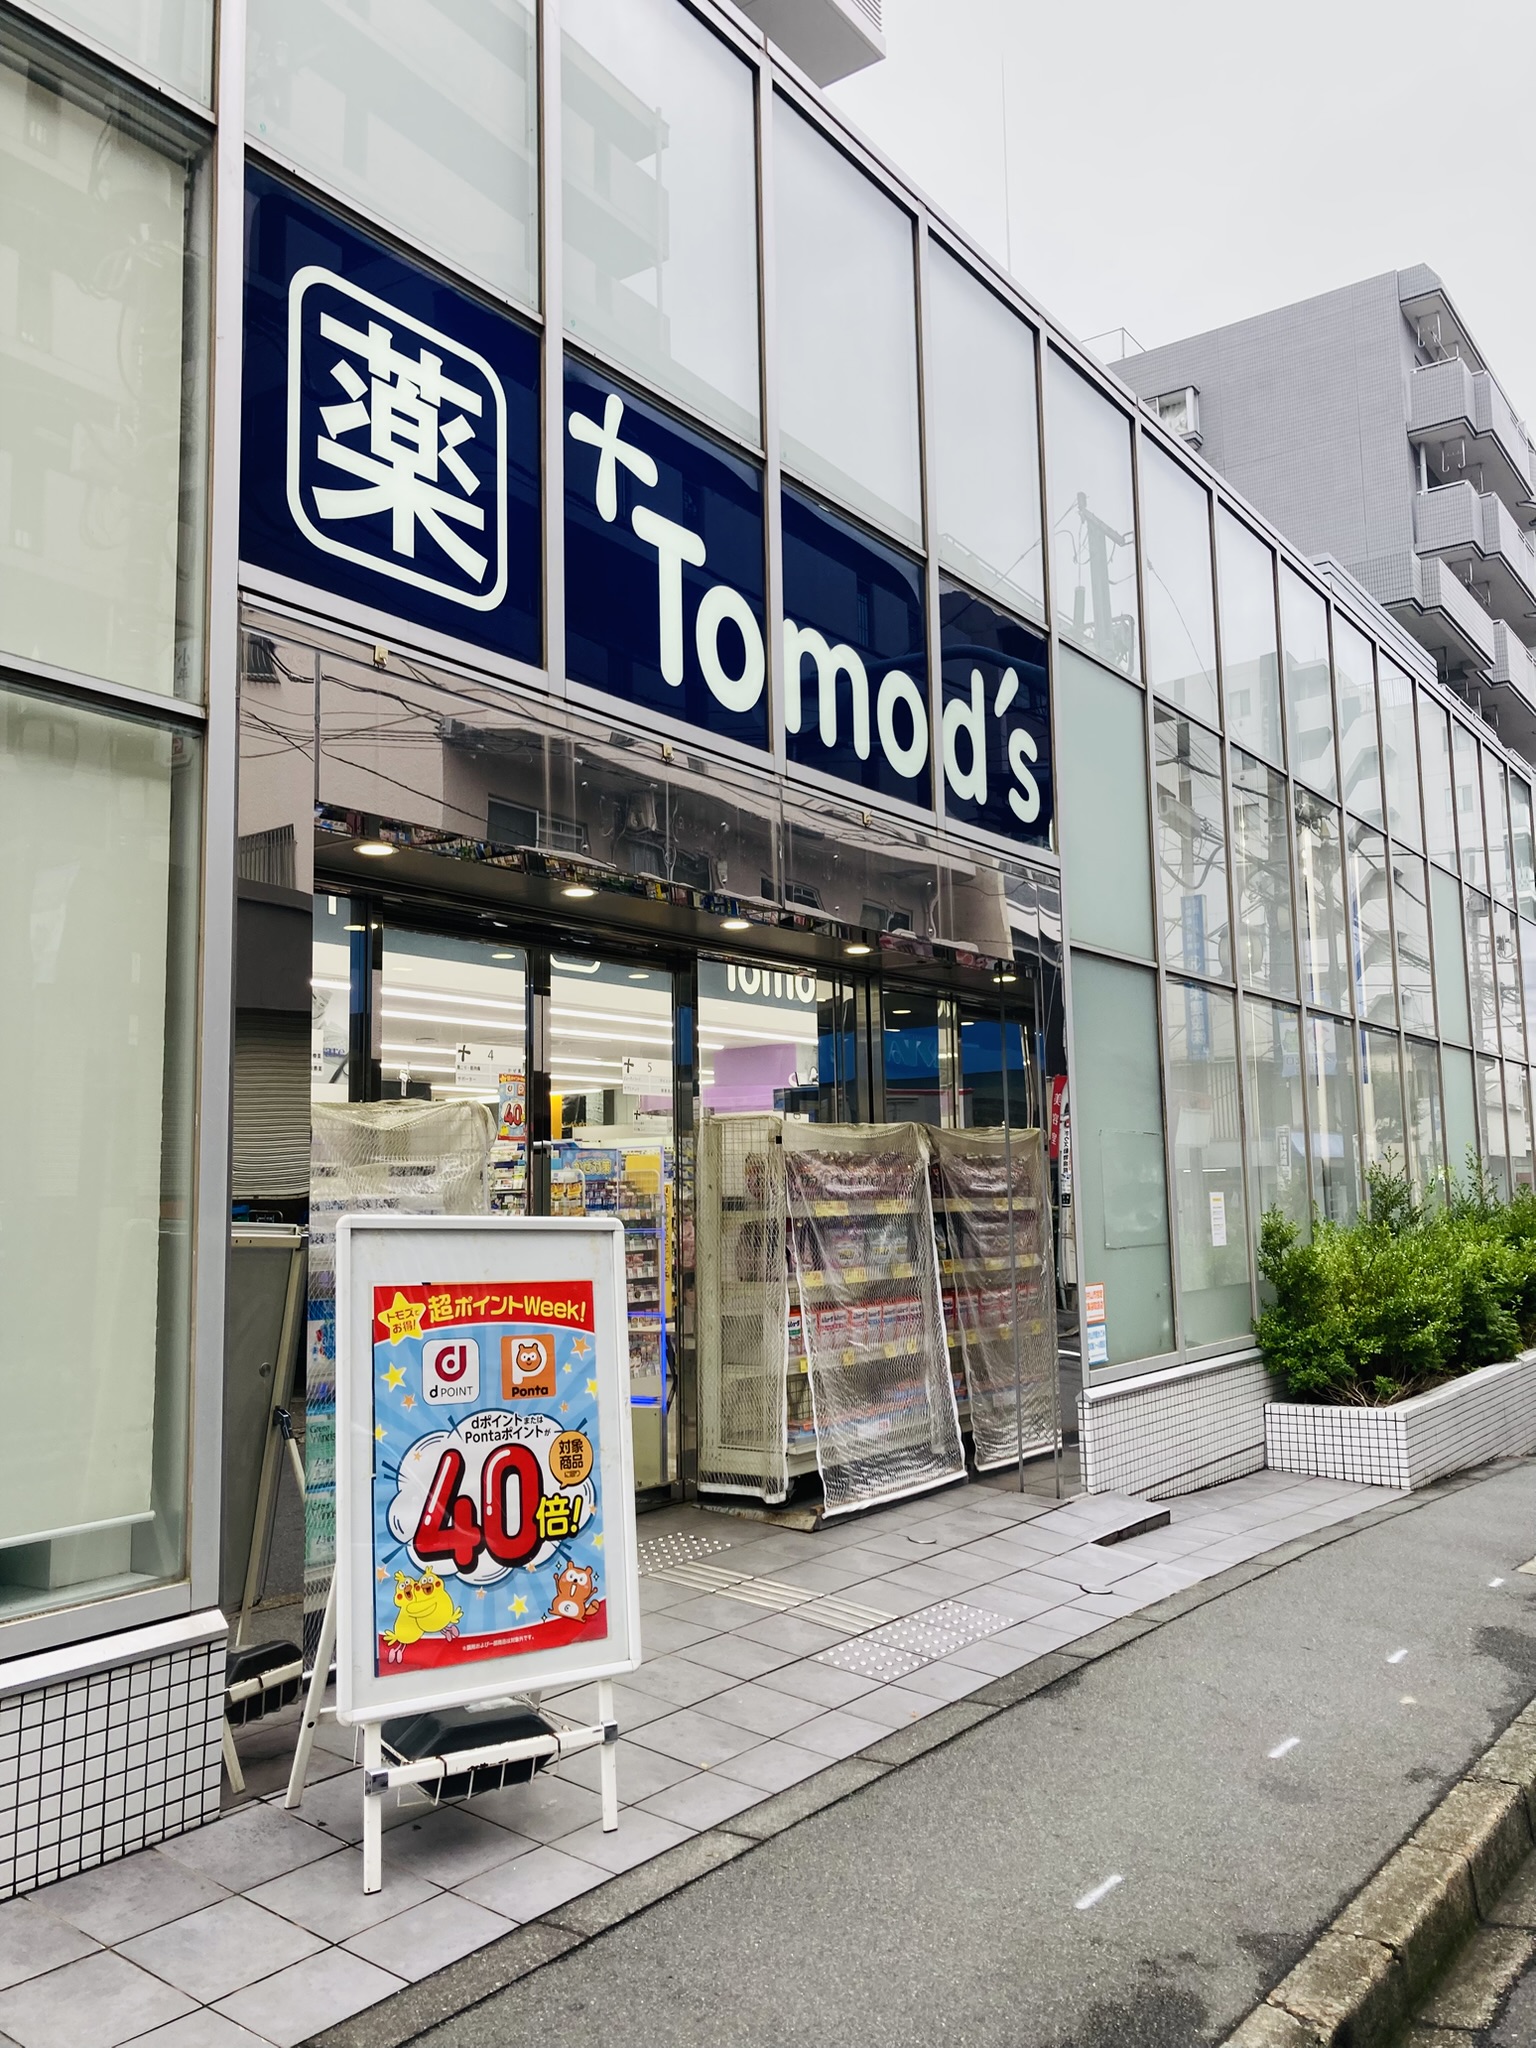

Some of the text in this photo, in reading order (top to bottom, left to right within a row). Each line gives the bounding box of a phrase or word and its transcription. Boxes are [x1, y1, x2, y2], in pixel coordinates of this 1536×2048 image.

[311, 311, 489, 584] 薬
[631, 505, 1041, 824] Tomod's
[487, 1049, 494, 1061] 4
[647, 1062, 653, 1073] 5
[427, 1293, 586, 1323] 超ポイントWeek!
[392, 1319, 416, 1334] お得!
[440, 1385, 473, 1397] POINT
[511, 1384, 549, 1398] Ponta
[465, 1425, 551, 1444] Pontaポイントが
[559, 1438, 583, 1455] 対象
[559, 1454, 584, 1470] 商品
